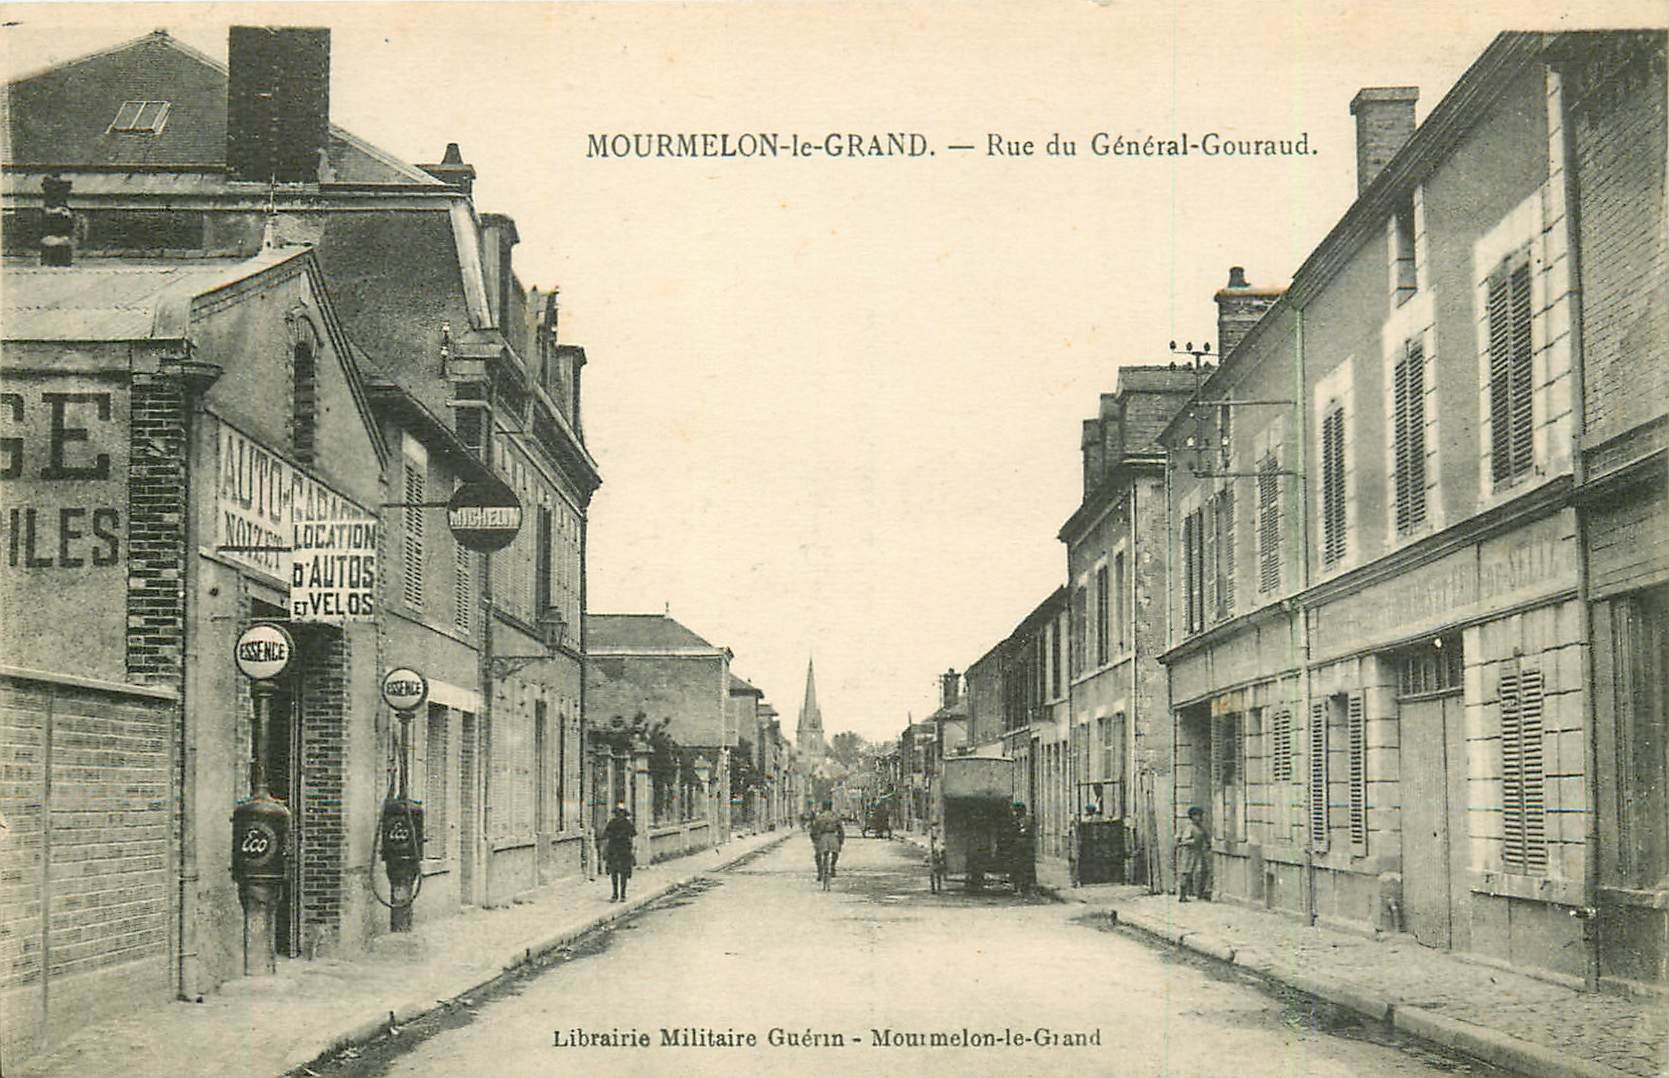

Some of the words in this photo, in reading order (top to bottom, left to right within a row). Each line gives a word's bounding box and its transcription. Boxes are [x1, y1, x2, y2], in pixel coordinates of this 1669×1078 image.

[293, 524, 376, 550] LOCATION
[292, 554, 375, 589] D'AUTOS
[308, 591, 374, 616] VELOS
[239, 639, 286, 663] ESSENCE
[386, 679, 421, 697] ESSENCE
[242, 829, 268, 853] Eco
[389, 821, 409, 840] Eco
